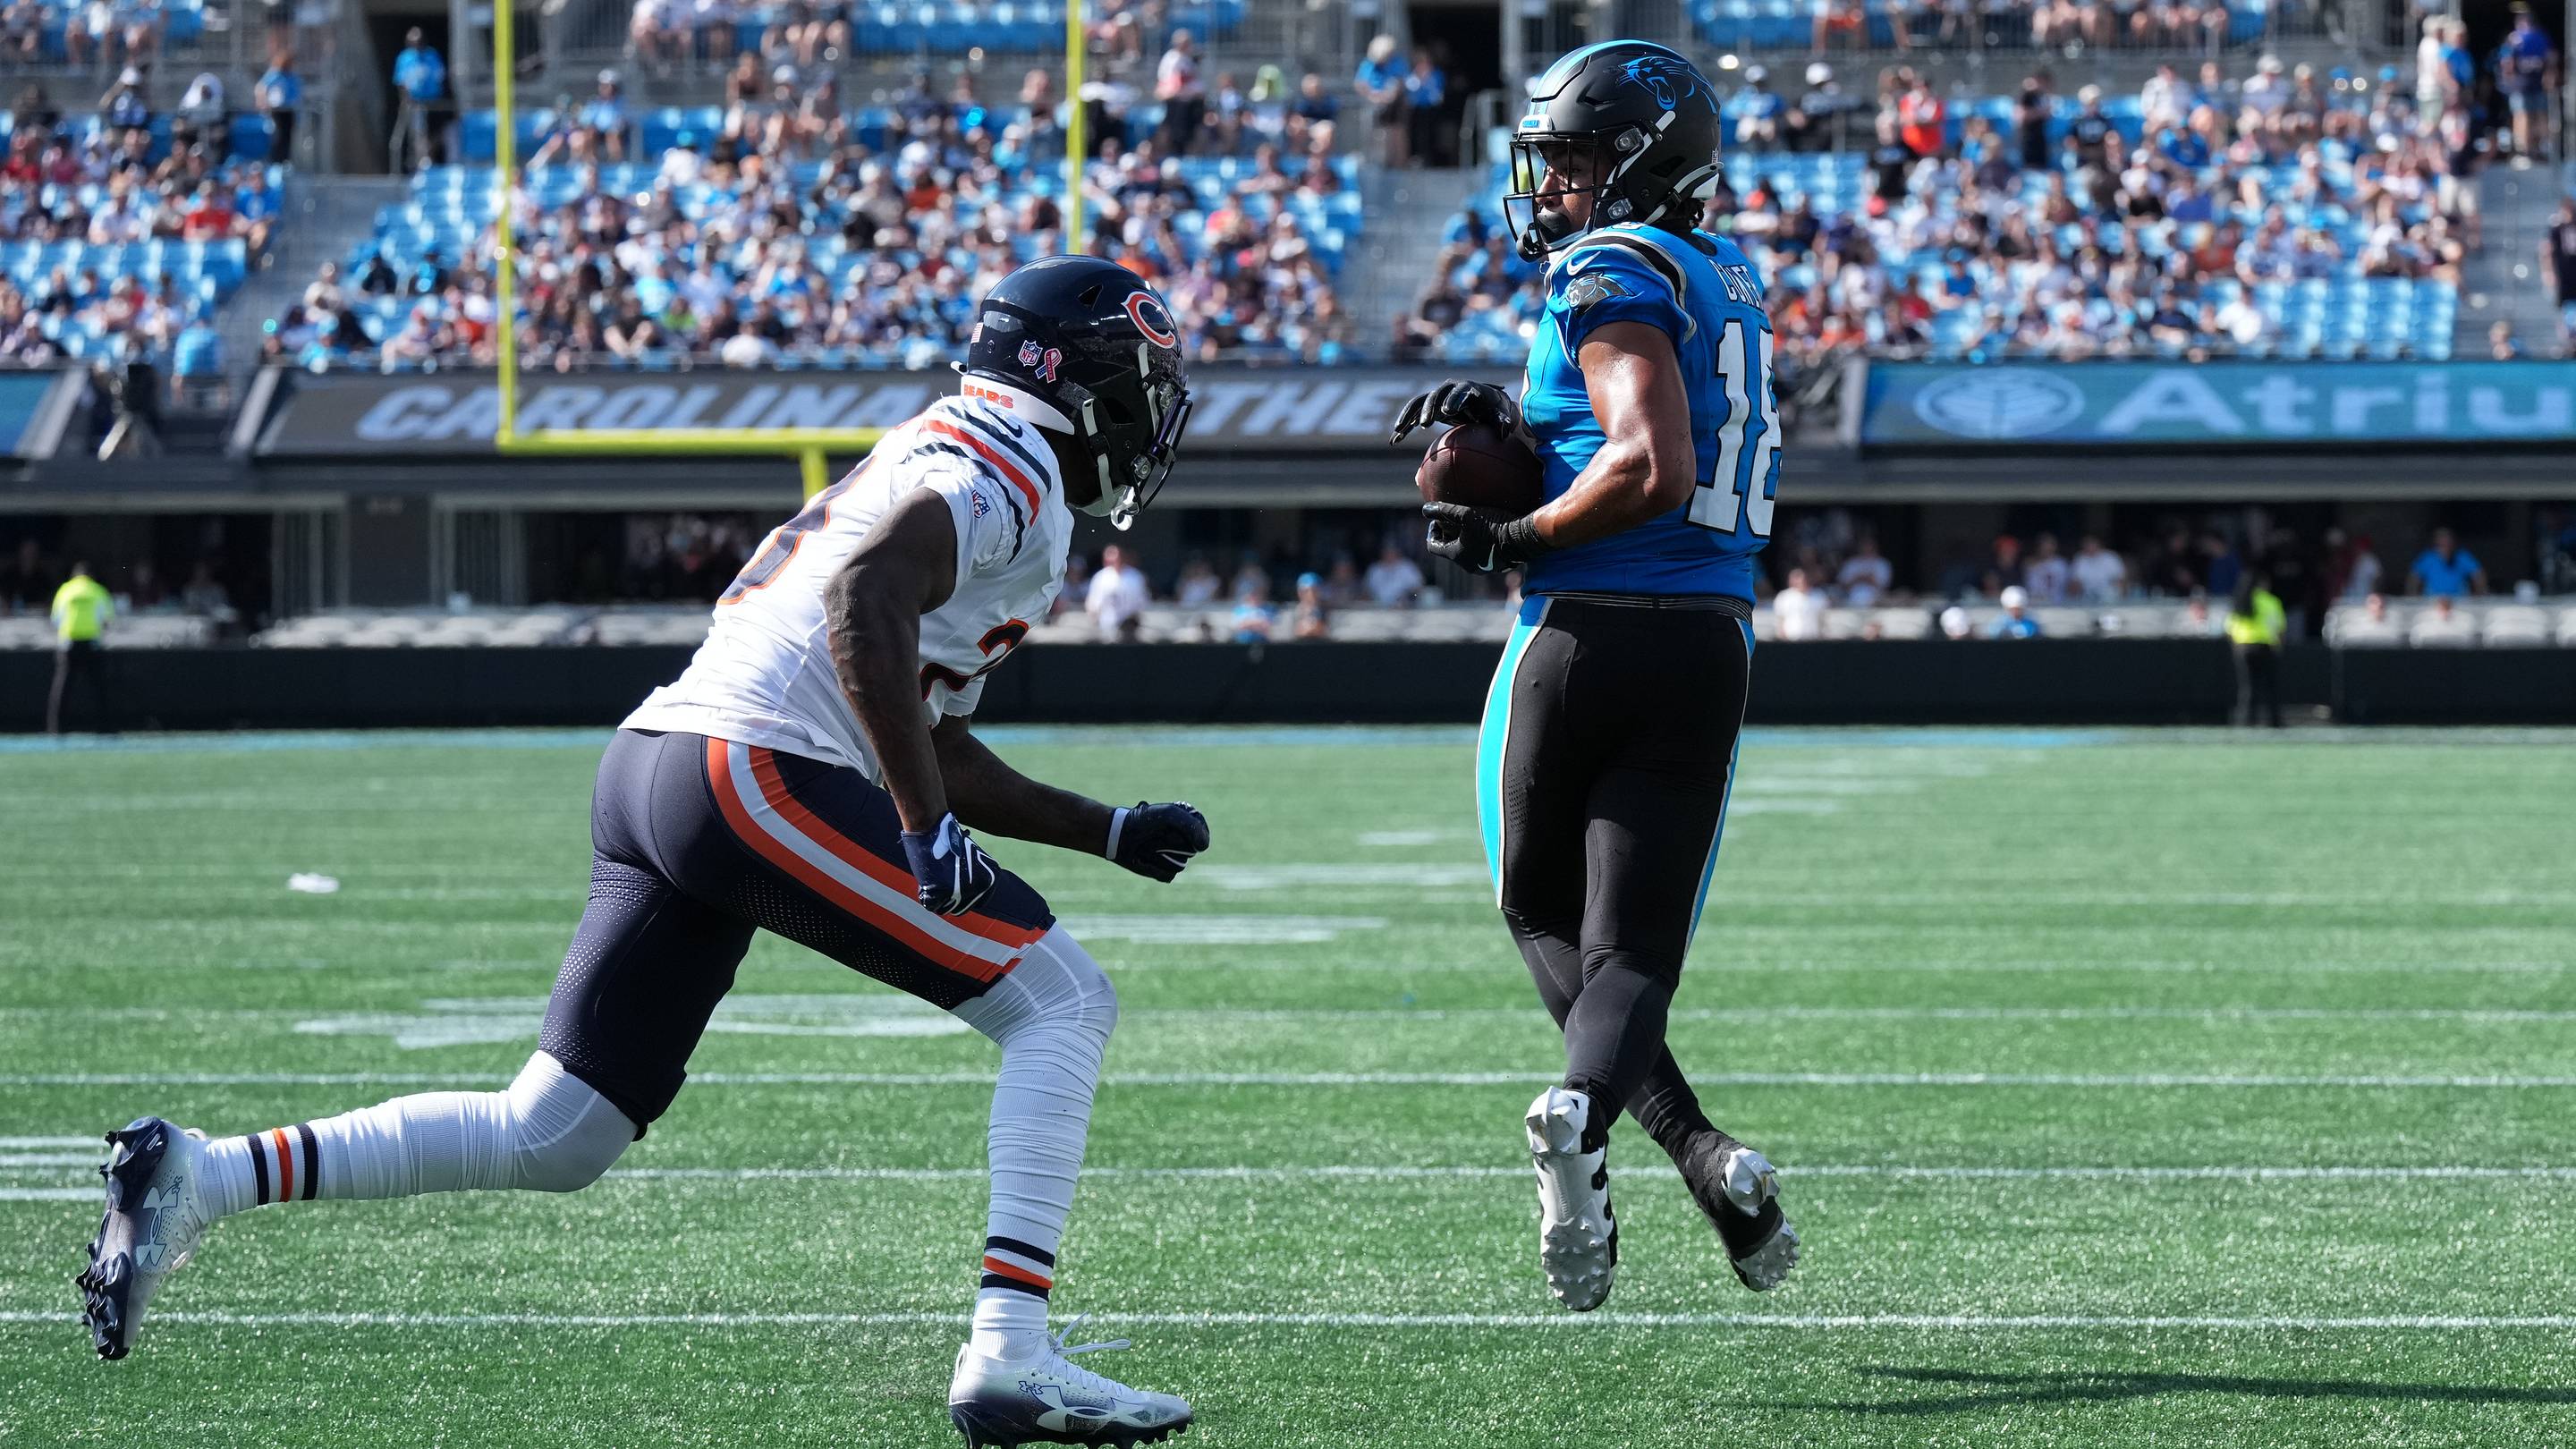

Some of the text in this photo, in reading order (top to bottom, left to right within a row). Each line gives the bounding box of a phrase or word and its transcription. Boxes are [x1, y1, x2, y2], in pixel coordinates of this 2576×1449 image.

[358, 385, 928, 442] CAROLINA
[963, 384, 1013, 409] BEARS
[2097, 369, 2572, 435] Atriu
